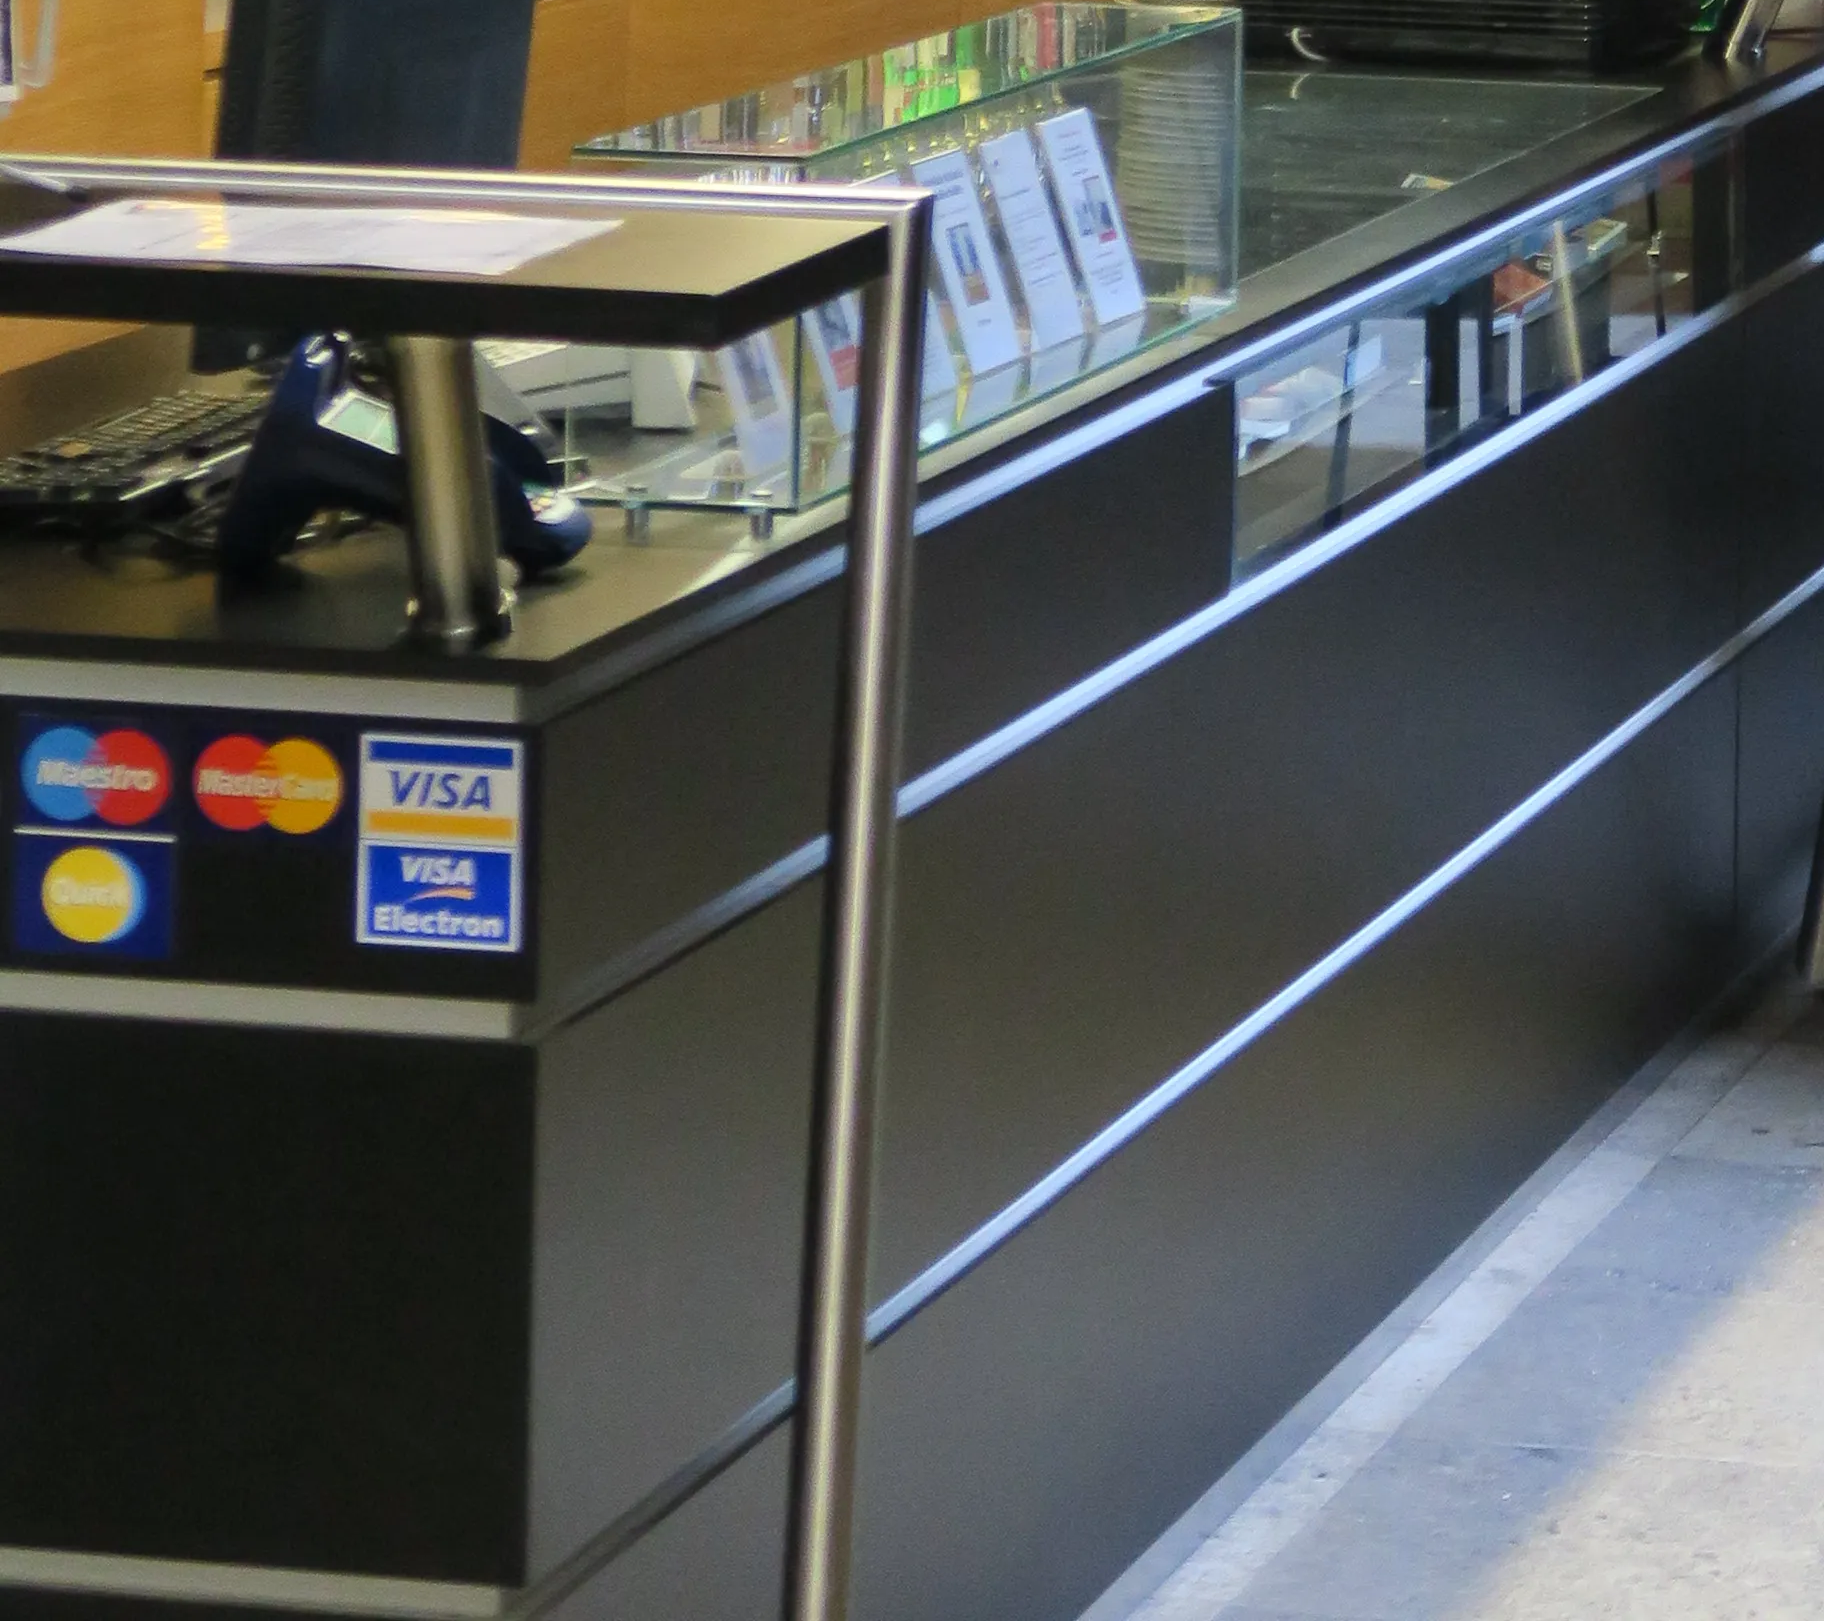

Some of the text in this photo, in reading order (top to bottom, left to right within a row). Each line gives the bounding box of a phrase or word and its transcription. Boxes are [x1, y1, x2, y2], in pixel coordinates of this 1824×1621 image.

[36, 759, 157, 792] Maestro
[388, 767, 493, 811] VISA
[400, 854, 476, 886] VISA
[372, 903, 506, 939] Electron
